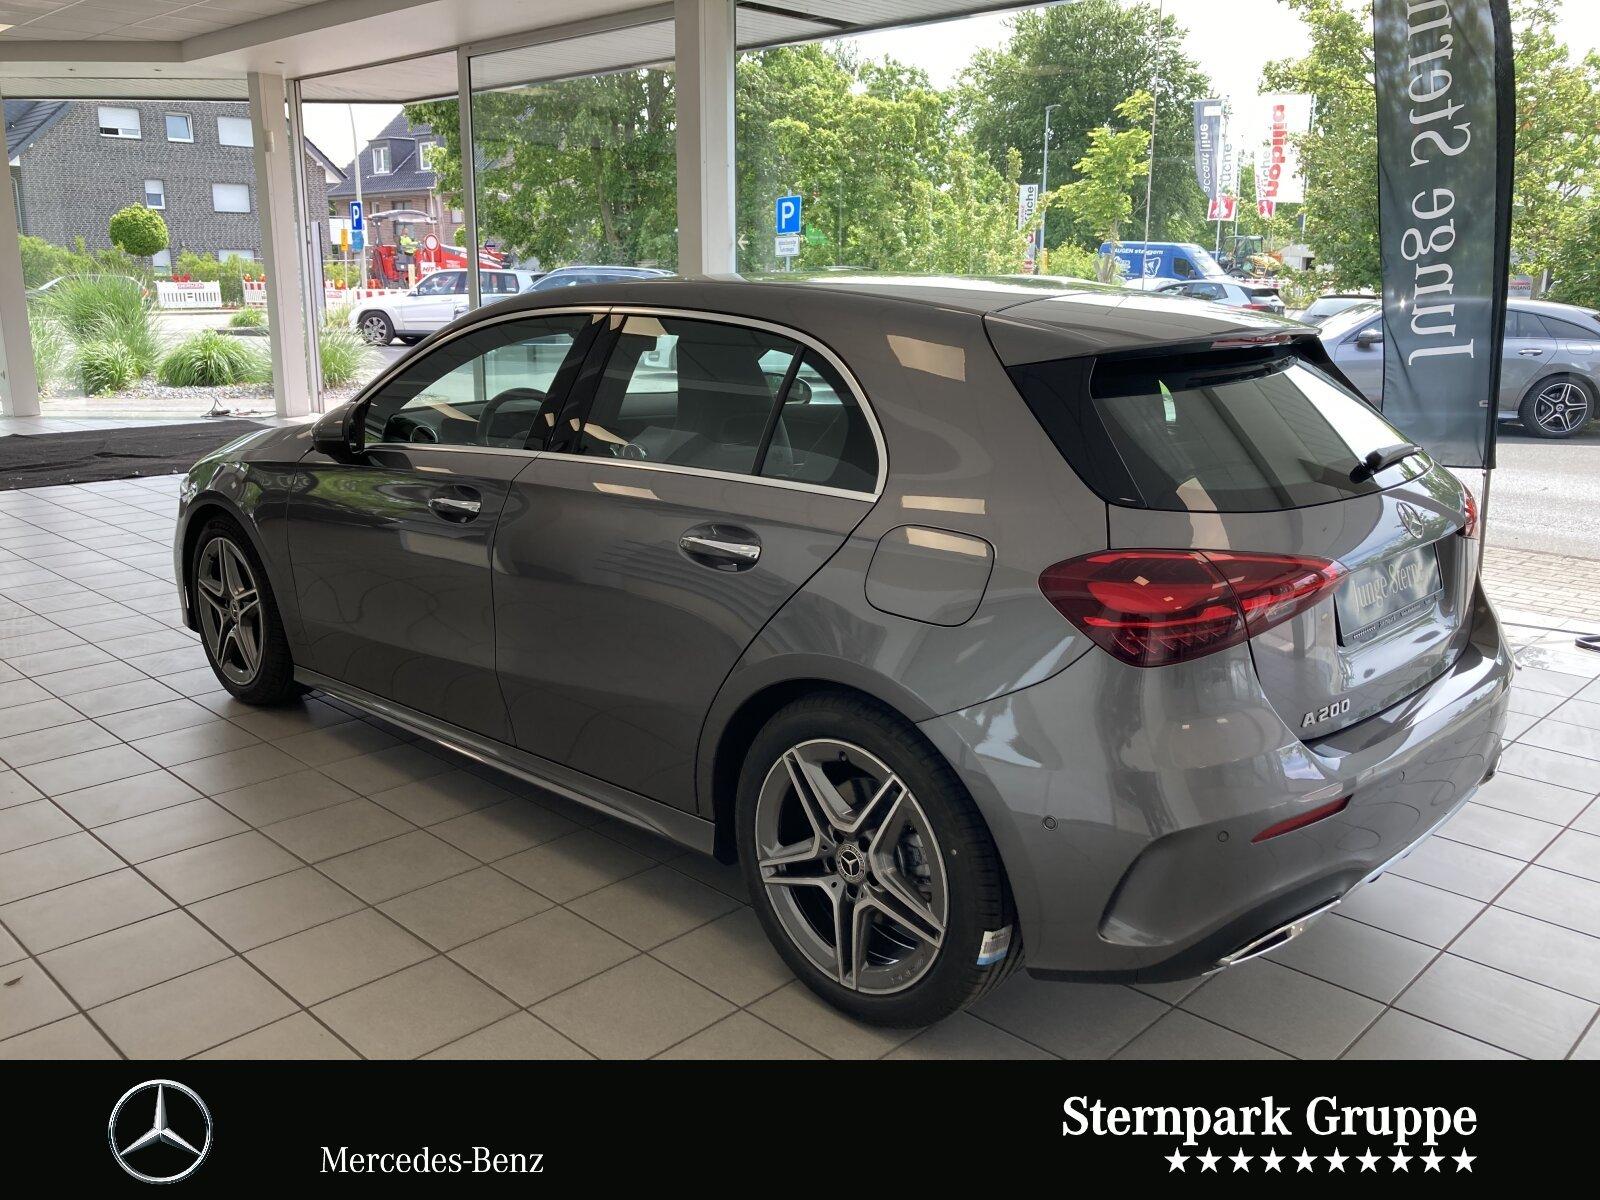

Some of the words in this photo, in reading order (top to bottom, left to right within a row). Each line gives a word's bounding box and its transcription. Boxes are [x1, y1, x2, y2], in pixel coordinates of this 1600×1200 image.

[1219, 144, 1232, 187] üche
[352, 205, 360, 227] P
[782, 201, 795, 230] P
[1025, 186, 1034, 222] üche
[1351, 575, 1388, 618] Junge
[1301, 711, 1316, 728] A
[1317, 698, 1350, 722] 200
